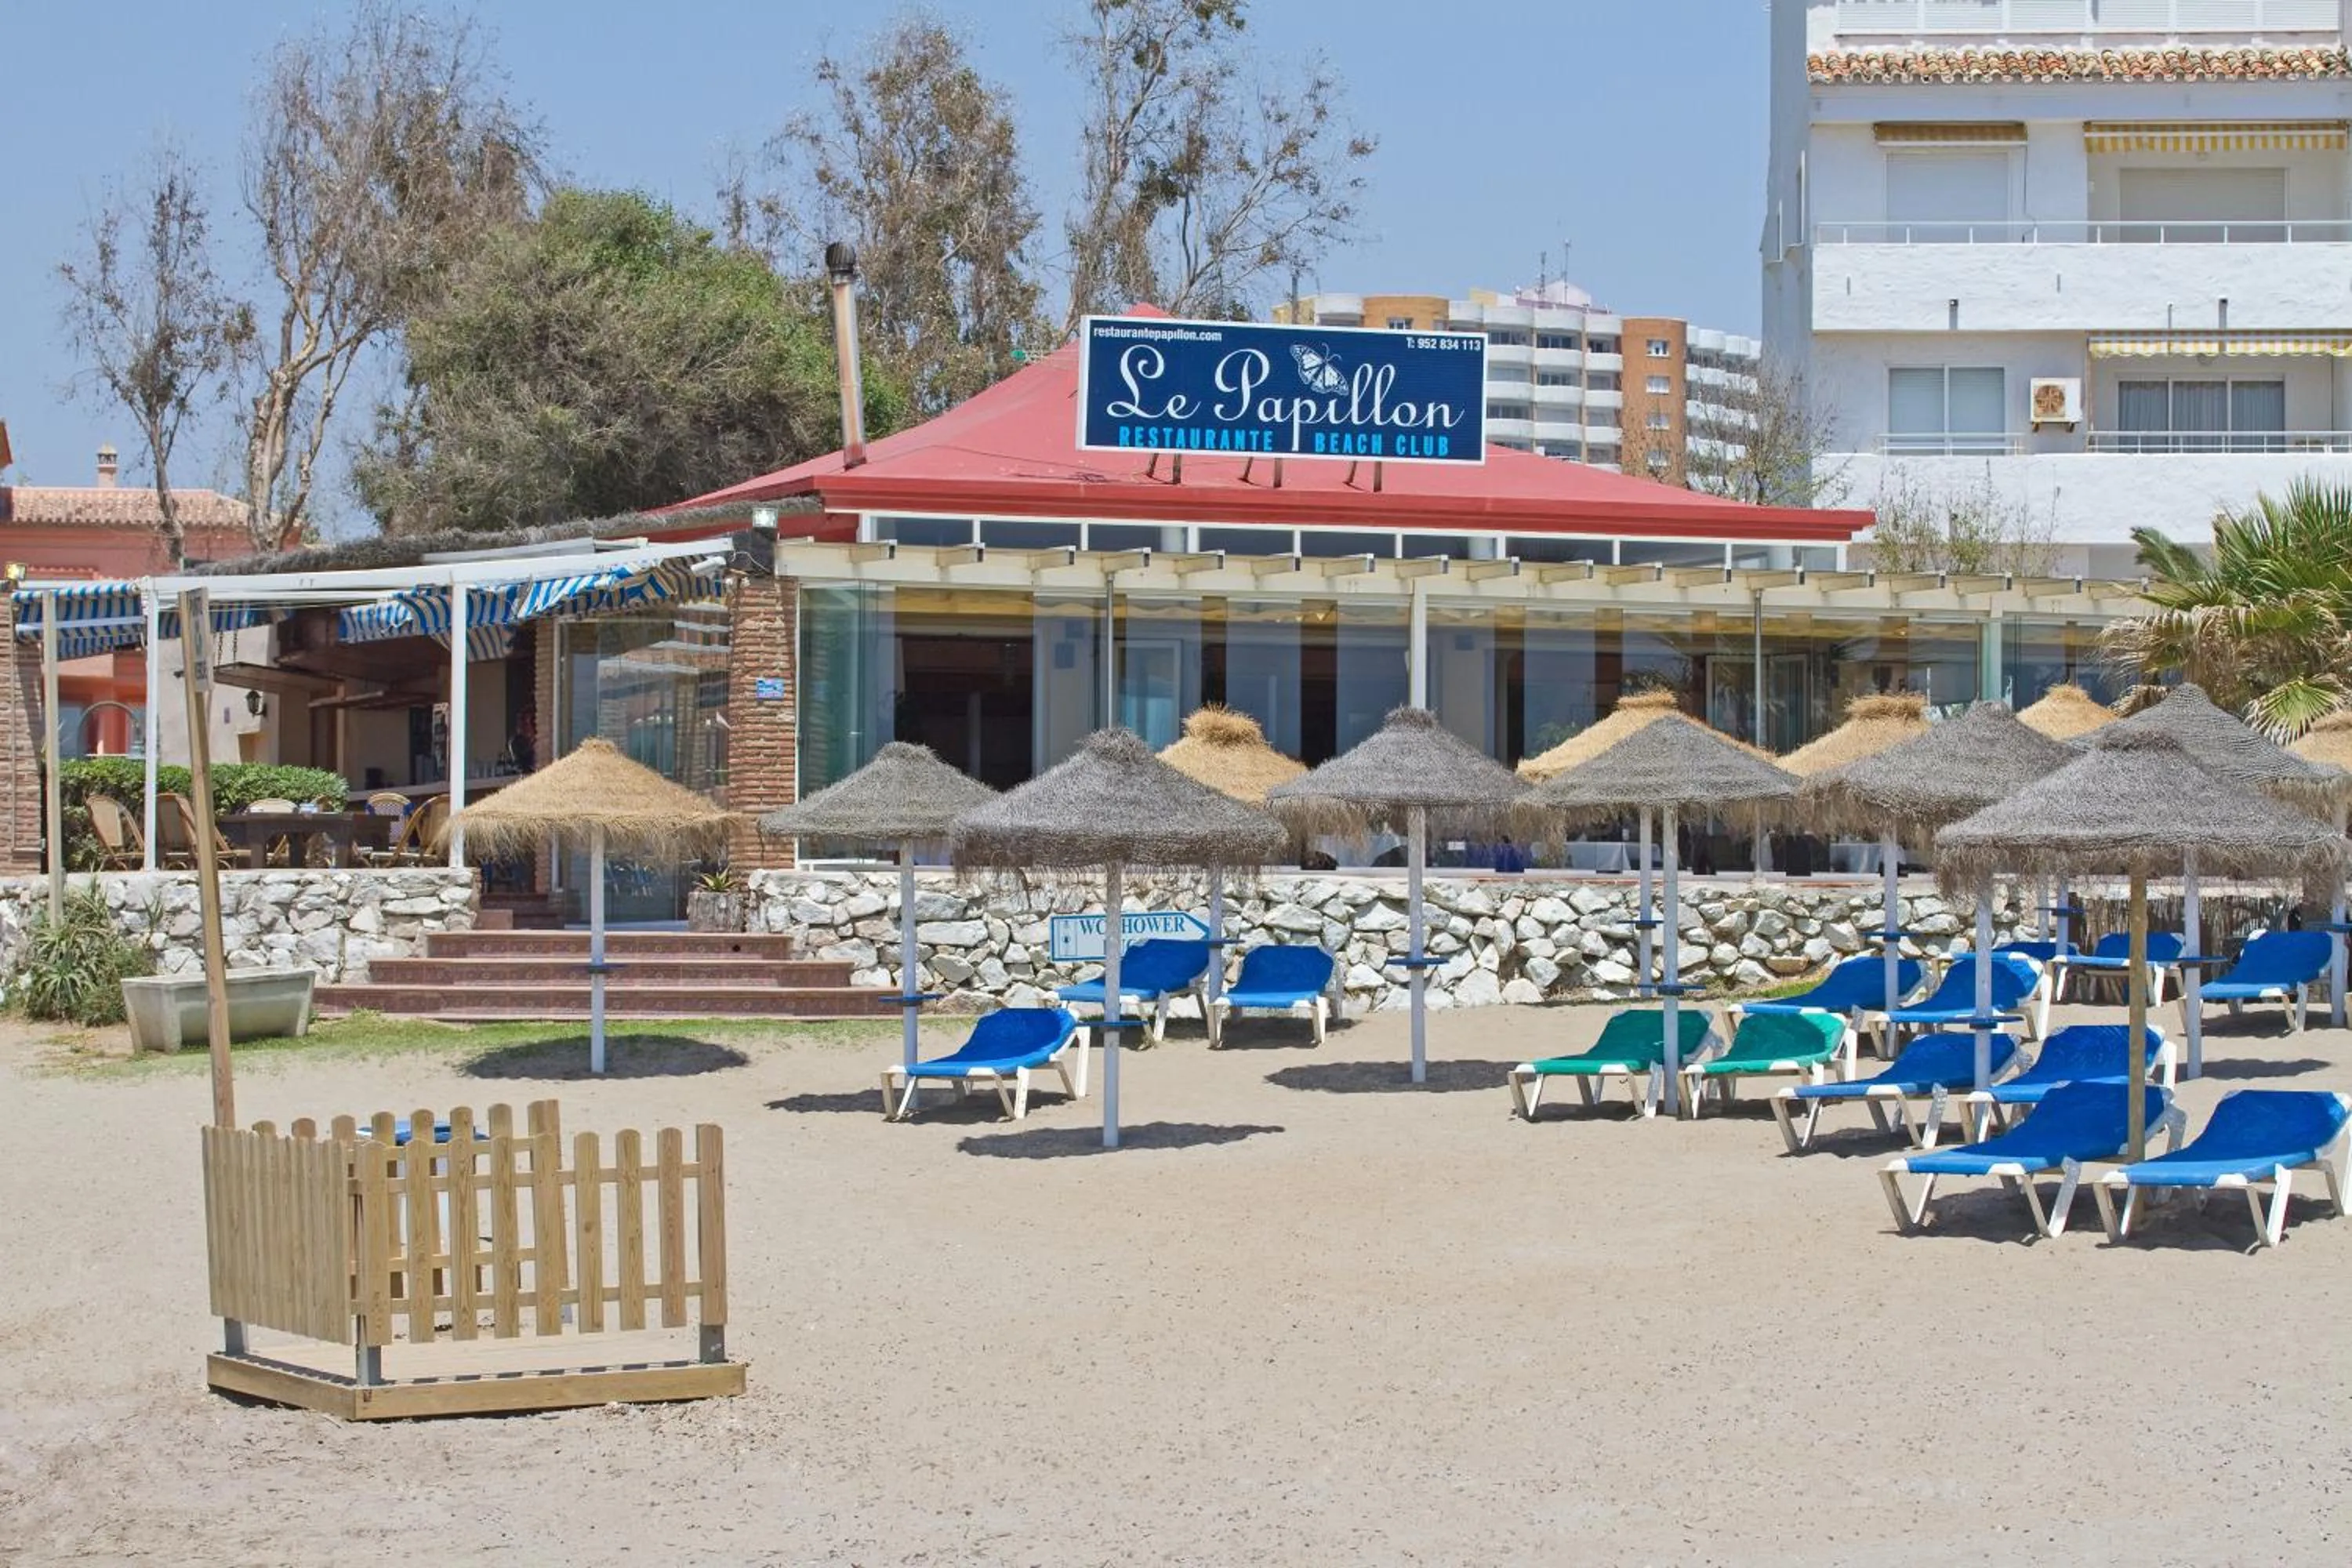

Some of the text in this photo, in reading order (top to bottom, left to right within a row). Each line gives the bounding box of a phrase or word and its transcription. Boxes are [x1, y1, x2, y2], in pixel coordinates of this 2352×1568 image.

[1094, 326, 1222, 342] restaurantepapillon.com
[1417, 338, 1437, 349] 952
[1439, 339, 1458, 350] 834
[1461, 339, 1481, 351] 113
[1106, 344, 1465, 452] Le Papillon
[1119, 426, 1449, 456] RESTAURANTE BEACH CLUB
[1121, 916, 1186, 934] HOWER
